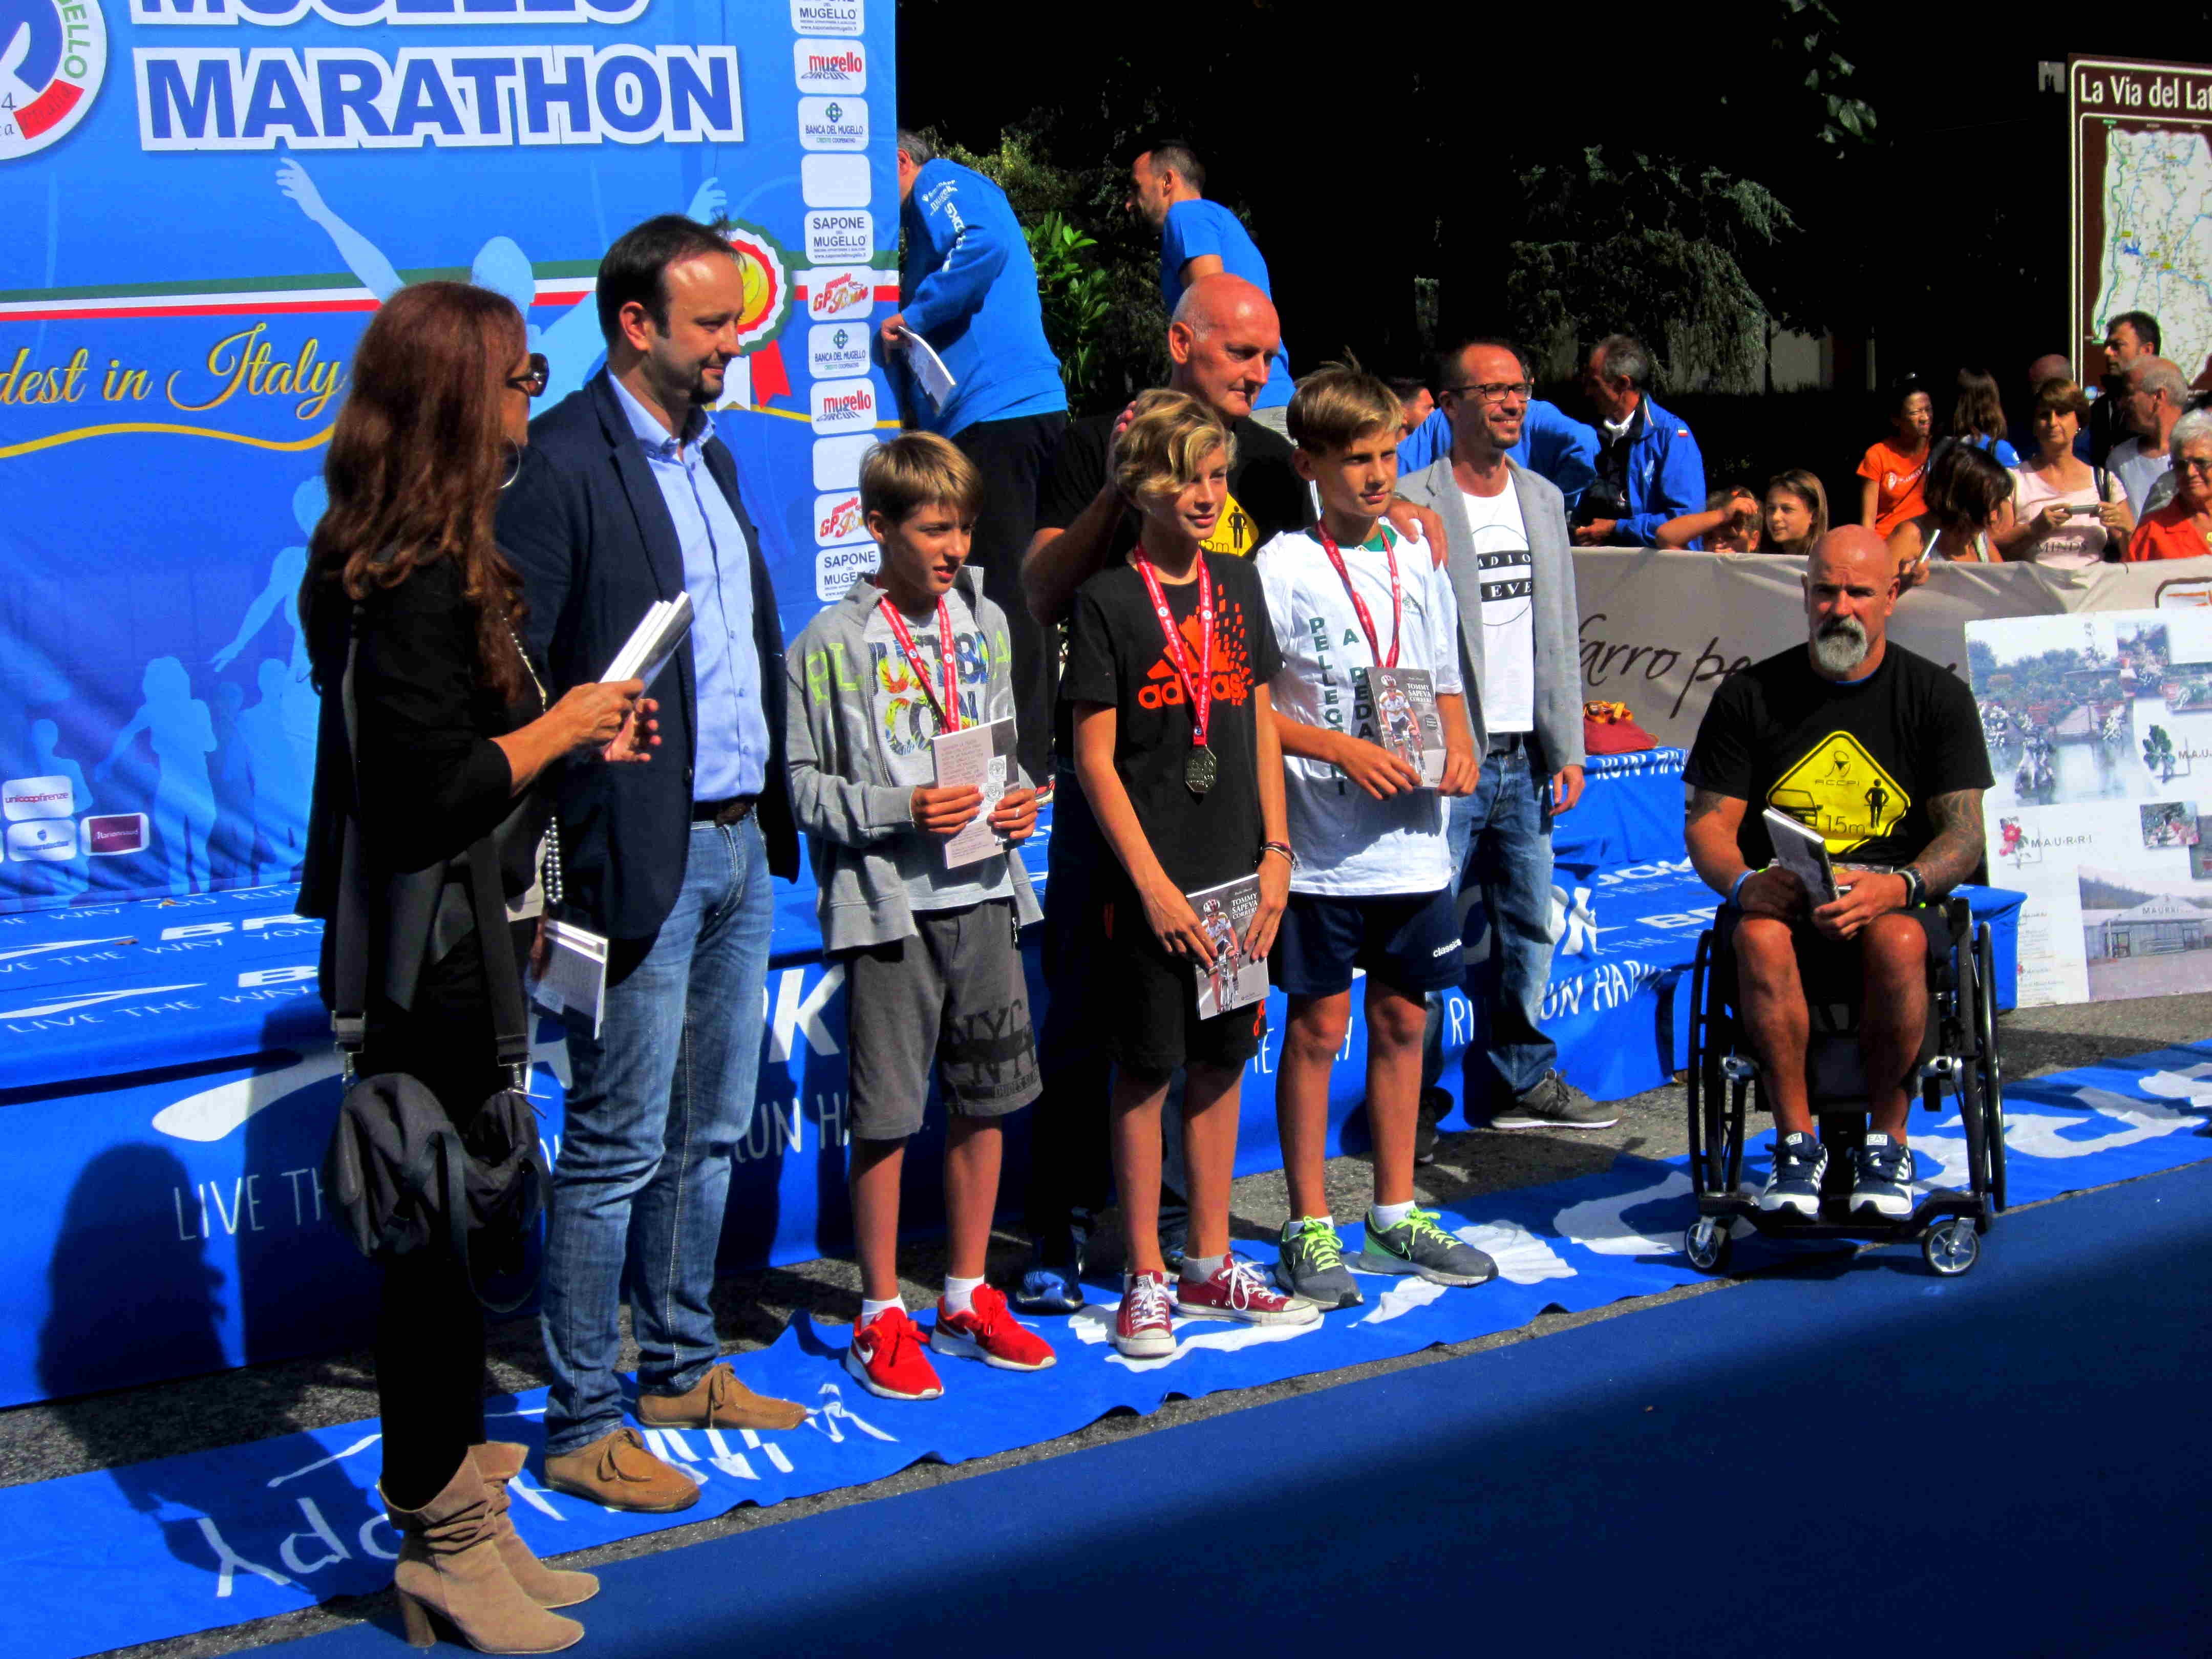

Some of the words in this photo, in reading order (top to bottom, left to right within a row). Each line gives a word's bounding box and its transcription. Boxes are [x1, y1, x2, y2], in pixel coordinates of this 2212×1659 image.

[799, 8, 857, 19] MUGELLO
[60, 0, 91, 78] ELLO
[809, 52, 862, 73] mugello
[141, 52, 737, 144] MARATHON
[2080, 73, 2103, 104] La
[2110, 75, 2143, 107] Via
[2149, 76, 2180, 109] del
[805, 124, 825, 135] BANCA
[827, 124, 837, 135] DEL
[838, 125, 863, 135] MUGELLO
[813, 217, 865, 230] SAPONE
[814, 236, 866, 247] MUGELLO
[813, 289, 833, 312] GP
[815, 352, 832, 363] BANCA
[833, 351, 843, 361] DEL
[844, 350, 866, 360] MUGELLO
[101, 359, 154, 402] in
[165, 322, 350, 421] Italy
[823, 390, 871, 413] mugello
[824, 550, 876, 569] SAPONE
[1478, 554, 1531, 567] ADIO
[1490, 581, 1532, 598] EVE
[1349, 667, 1374, 739] PEDA
[5, 792, 70, 804] unicoopfirenze
[1231, 892, 1257, 906] TOMMY
[1232, 900, 1258, 914] SAPEVA
[47, 951, 128, 966] THE
[142, 938, 223, 954] WAY
[244, 925, 325, 940] YOU
[1433, 938, 1463, 959] classics
[1539, 974, 1584, 1020] UN
[6, 1013, 105, 1033] LIVE
[112, 999, 202, 1017] THE
[218, 985, 310, 1004] WAY
[734, 1097, 802, 1164] UN
[174, 1174, 265, 1241] LIVE
